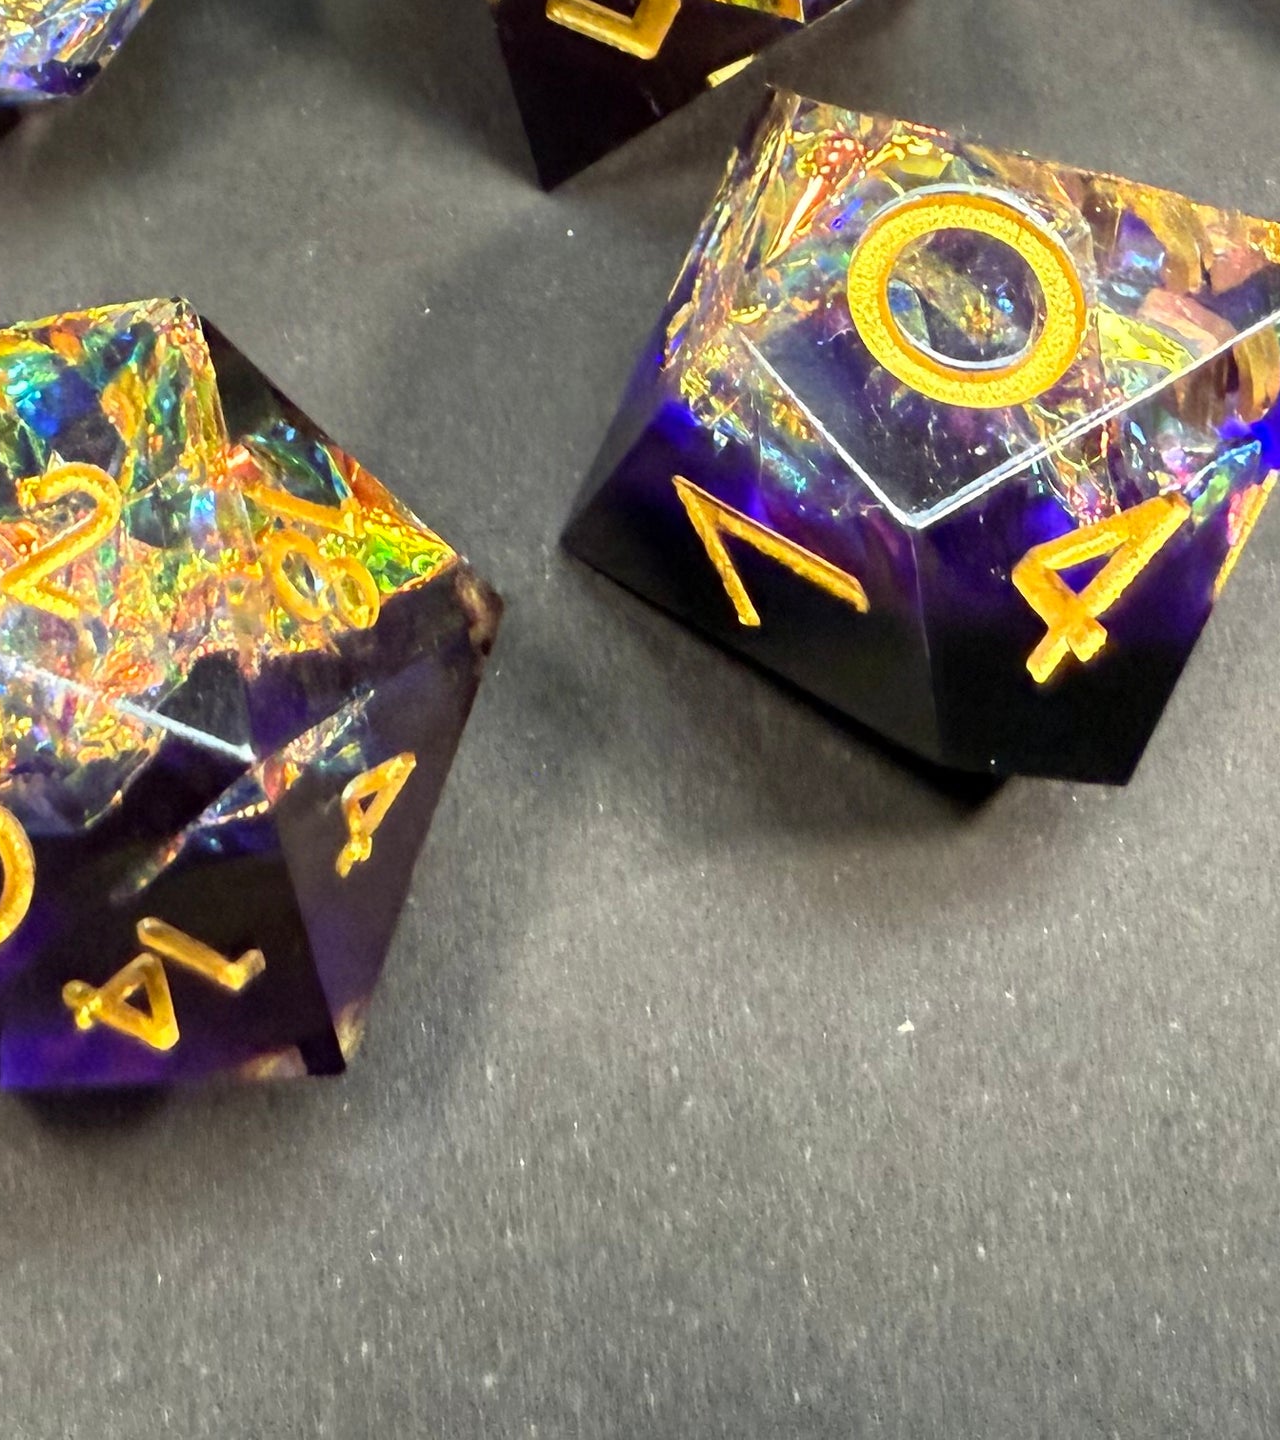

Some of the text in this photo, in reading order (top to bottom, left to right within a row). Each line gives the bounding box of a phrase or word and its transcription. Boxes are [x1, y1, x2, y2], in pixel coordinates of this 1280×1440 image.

[846, 192, 1088, 410] 0
[1010, 490, 1192, 686] 4
[334, 750, 418, 880] 4
[60, 914, 268, 1052] 14
